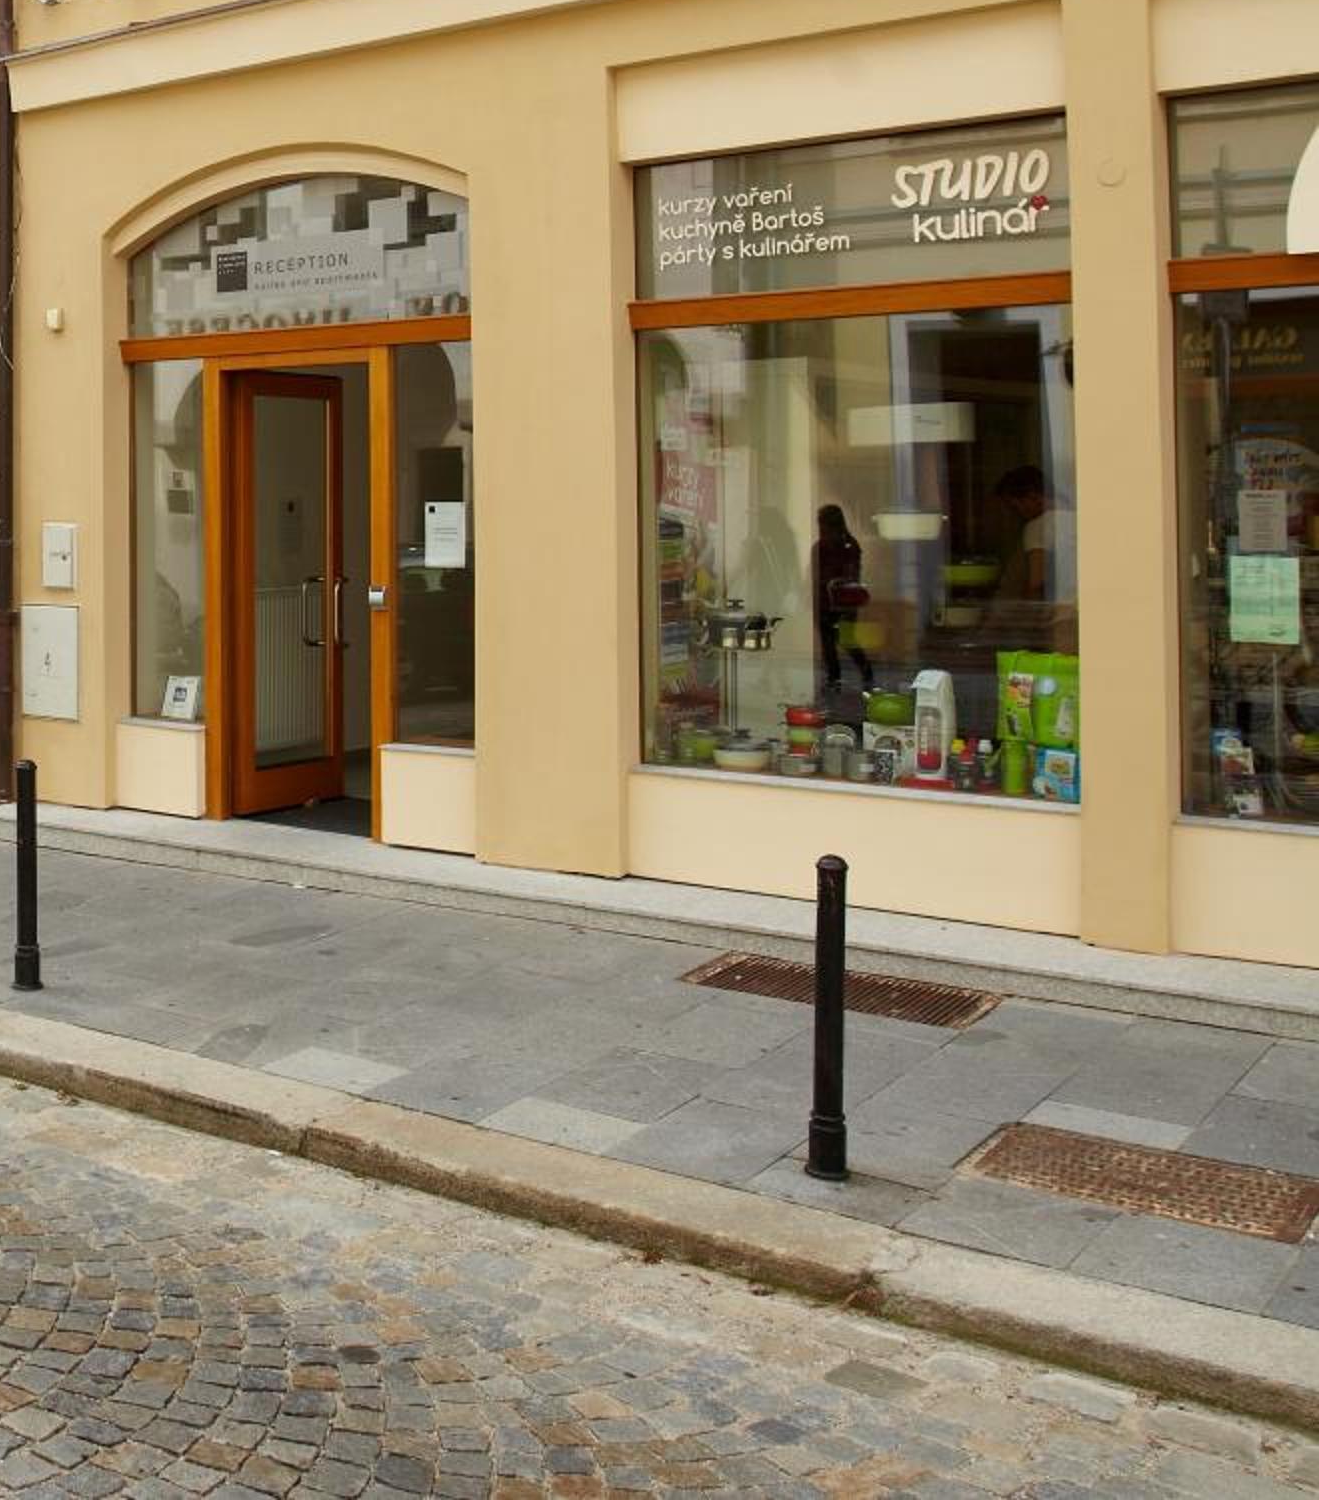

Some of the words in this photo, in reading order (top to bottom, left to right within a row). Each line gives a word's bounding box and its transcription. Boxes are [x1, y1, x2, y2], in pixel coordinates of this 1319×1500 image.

[891, 149, 1050, 209] STUDIO
[658, 197, 716, 217] kurzy
[723, 182, 793, 209] vaření
[659, 214, 745, 242] kuchyně
[752, 206, 824, 232] Bartoš
[253, 252, 349, 275] RECEPTION
[660, 244, 716, 271] párty
[722, 245, 734, 260] s
[739, 232, 850, 259] kulinářem
